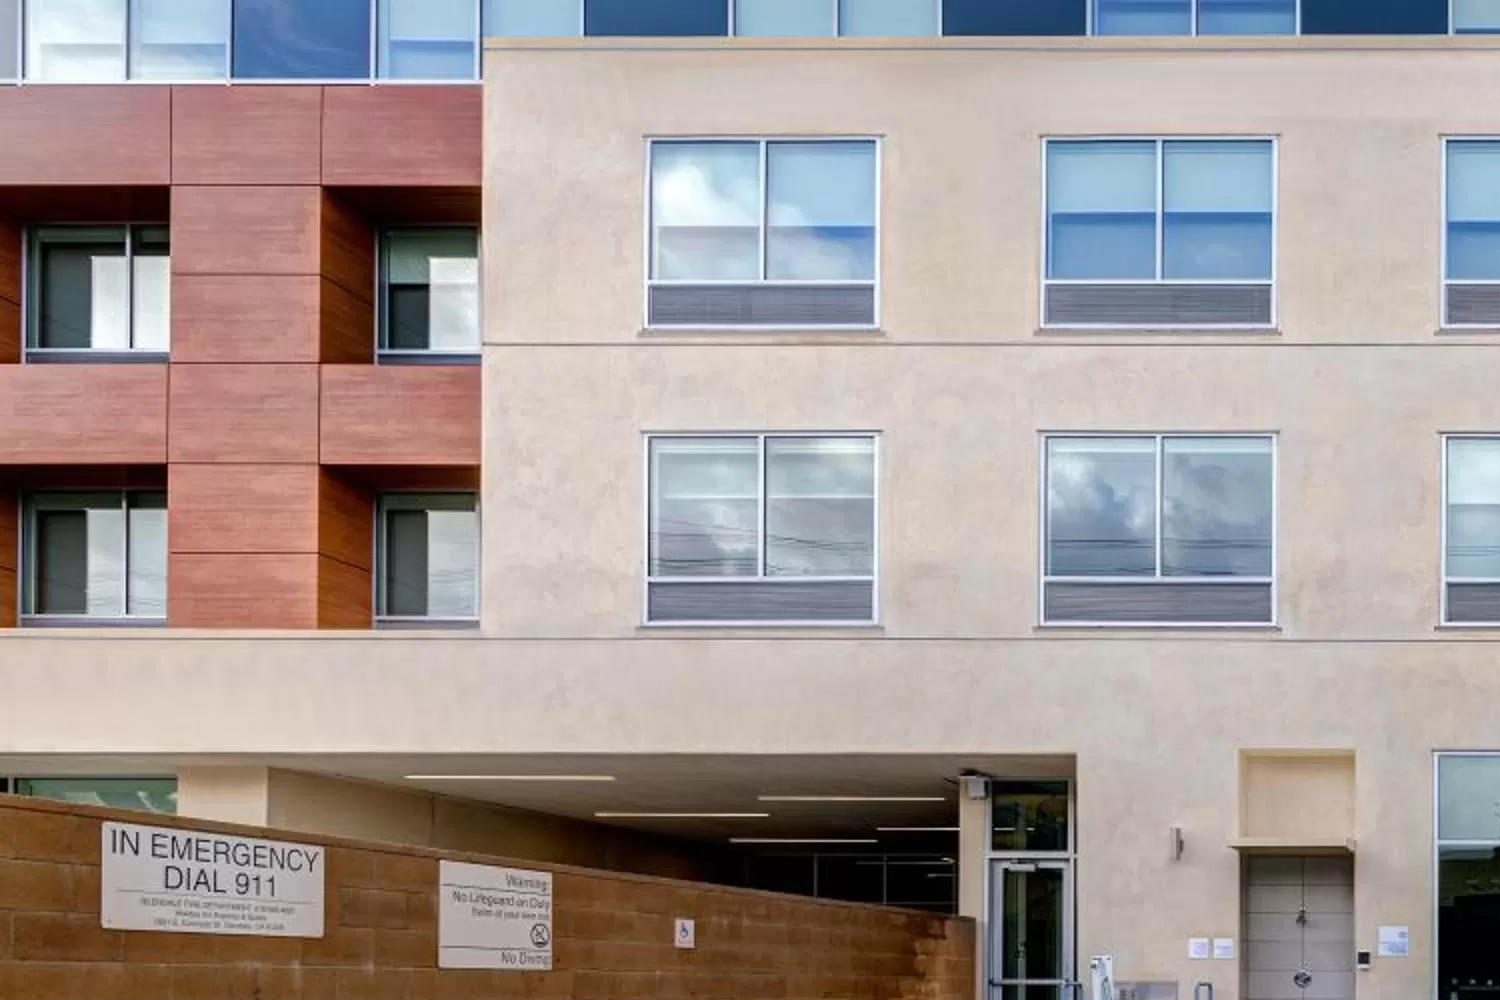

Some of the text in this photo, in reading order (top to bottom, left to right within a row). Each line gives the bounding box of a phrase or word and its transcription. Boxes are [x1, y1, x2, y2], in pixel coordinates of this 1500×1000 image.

[110, 829, 319, 873] IN EMERGENCY
[165, 865, 276, 897] DIAL 911
[502, 951, 517, 965] No
